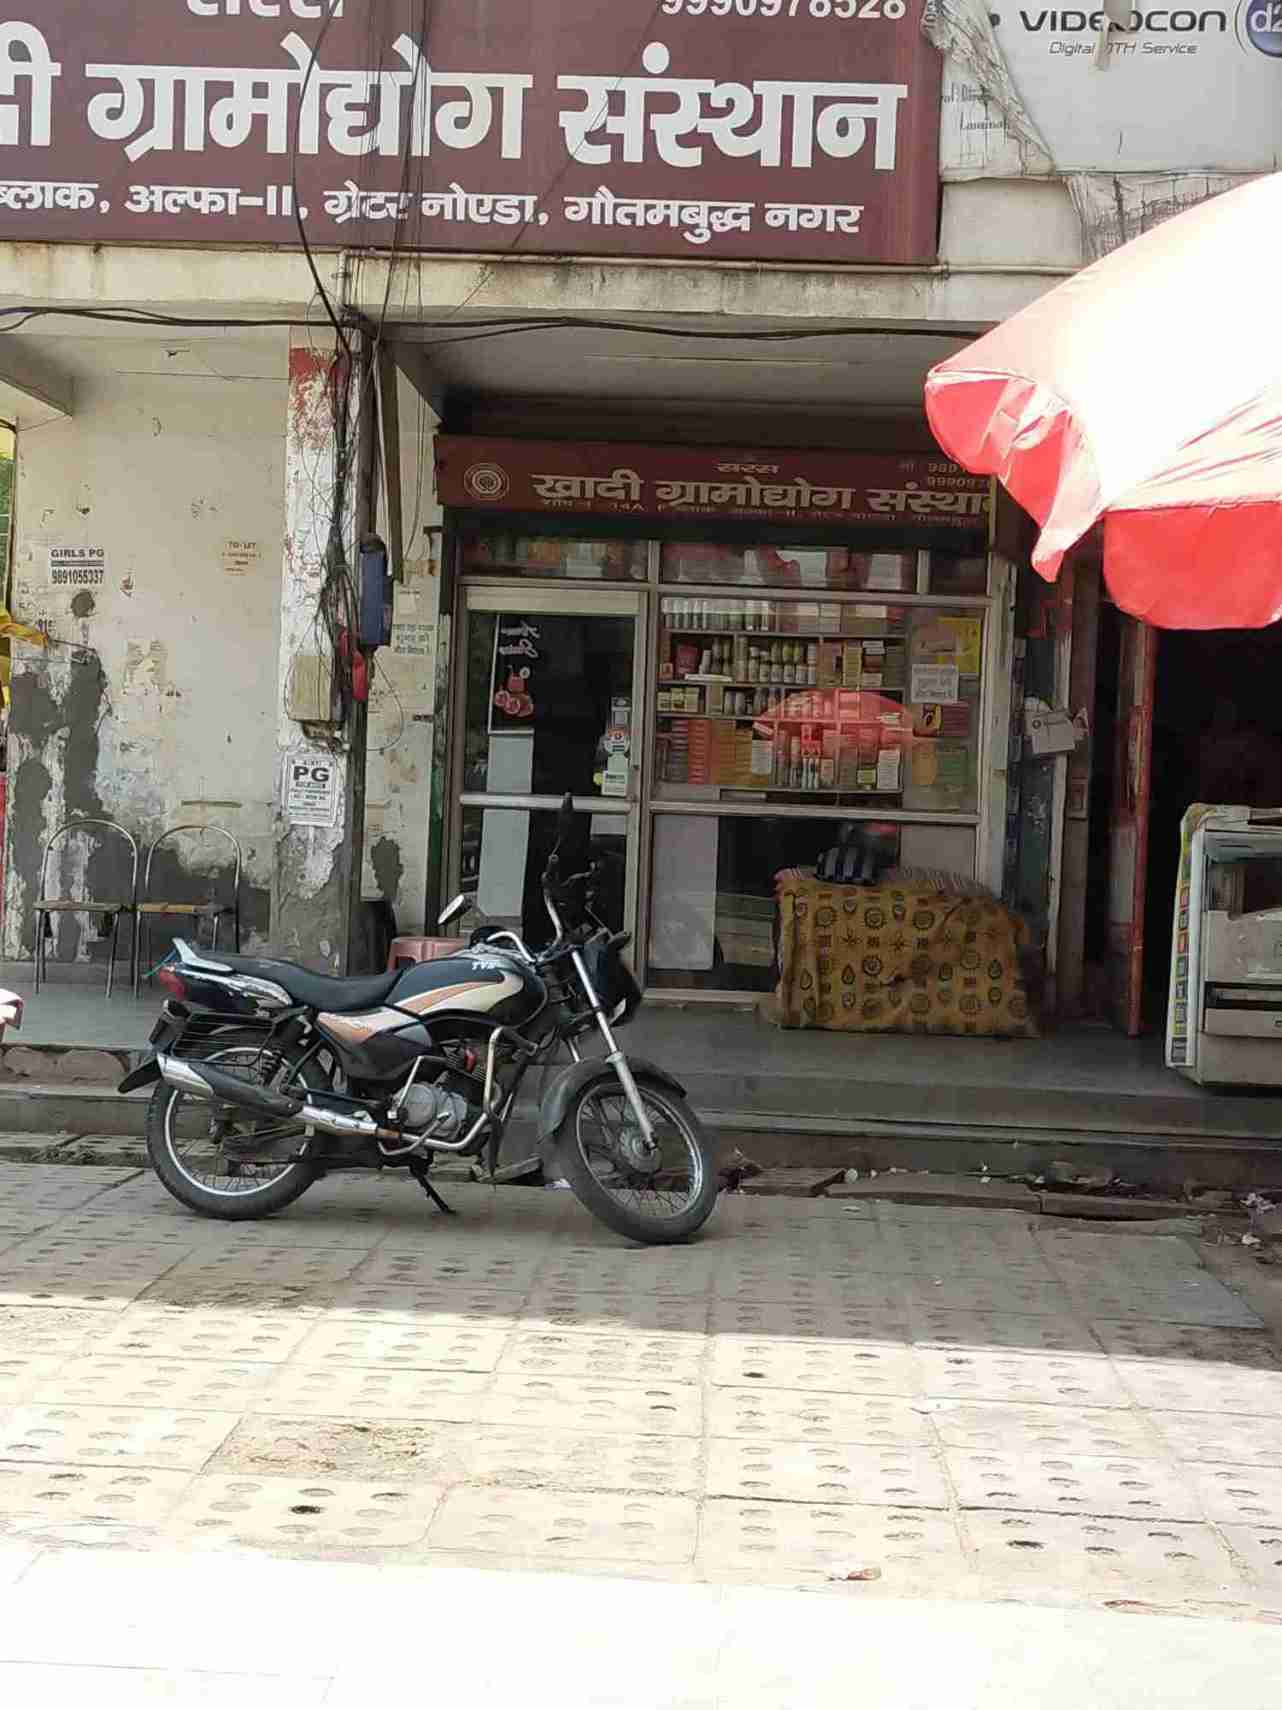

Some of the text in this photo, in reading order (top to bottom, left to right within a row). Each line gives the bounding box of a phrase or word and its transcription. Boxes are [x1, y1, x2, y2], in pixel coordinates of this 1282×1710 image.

[1049, 40, 1096, 57] Digital
[1141, 42, 1200, 55] Service
[557, 42, 907, 170] संस्थान
[564, 186, 754, 243] गौतमबुद्ध
[765, 200, 864, 233] नगर
[530, 468, 645, 501] खादी
[654, 474, 857, 509] ग्रामोद्योग
[51, 548, 104, 558] GIRLS PG
[293, 765, 330, 782] PG
